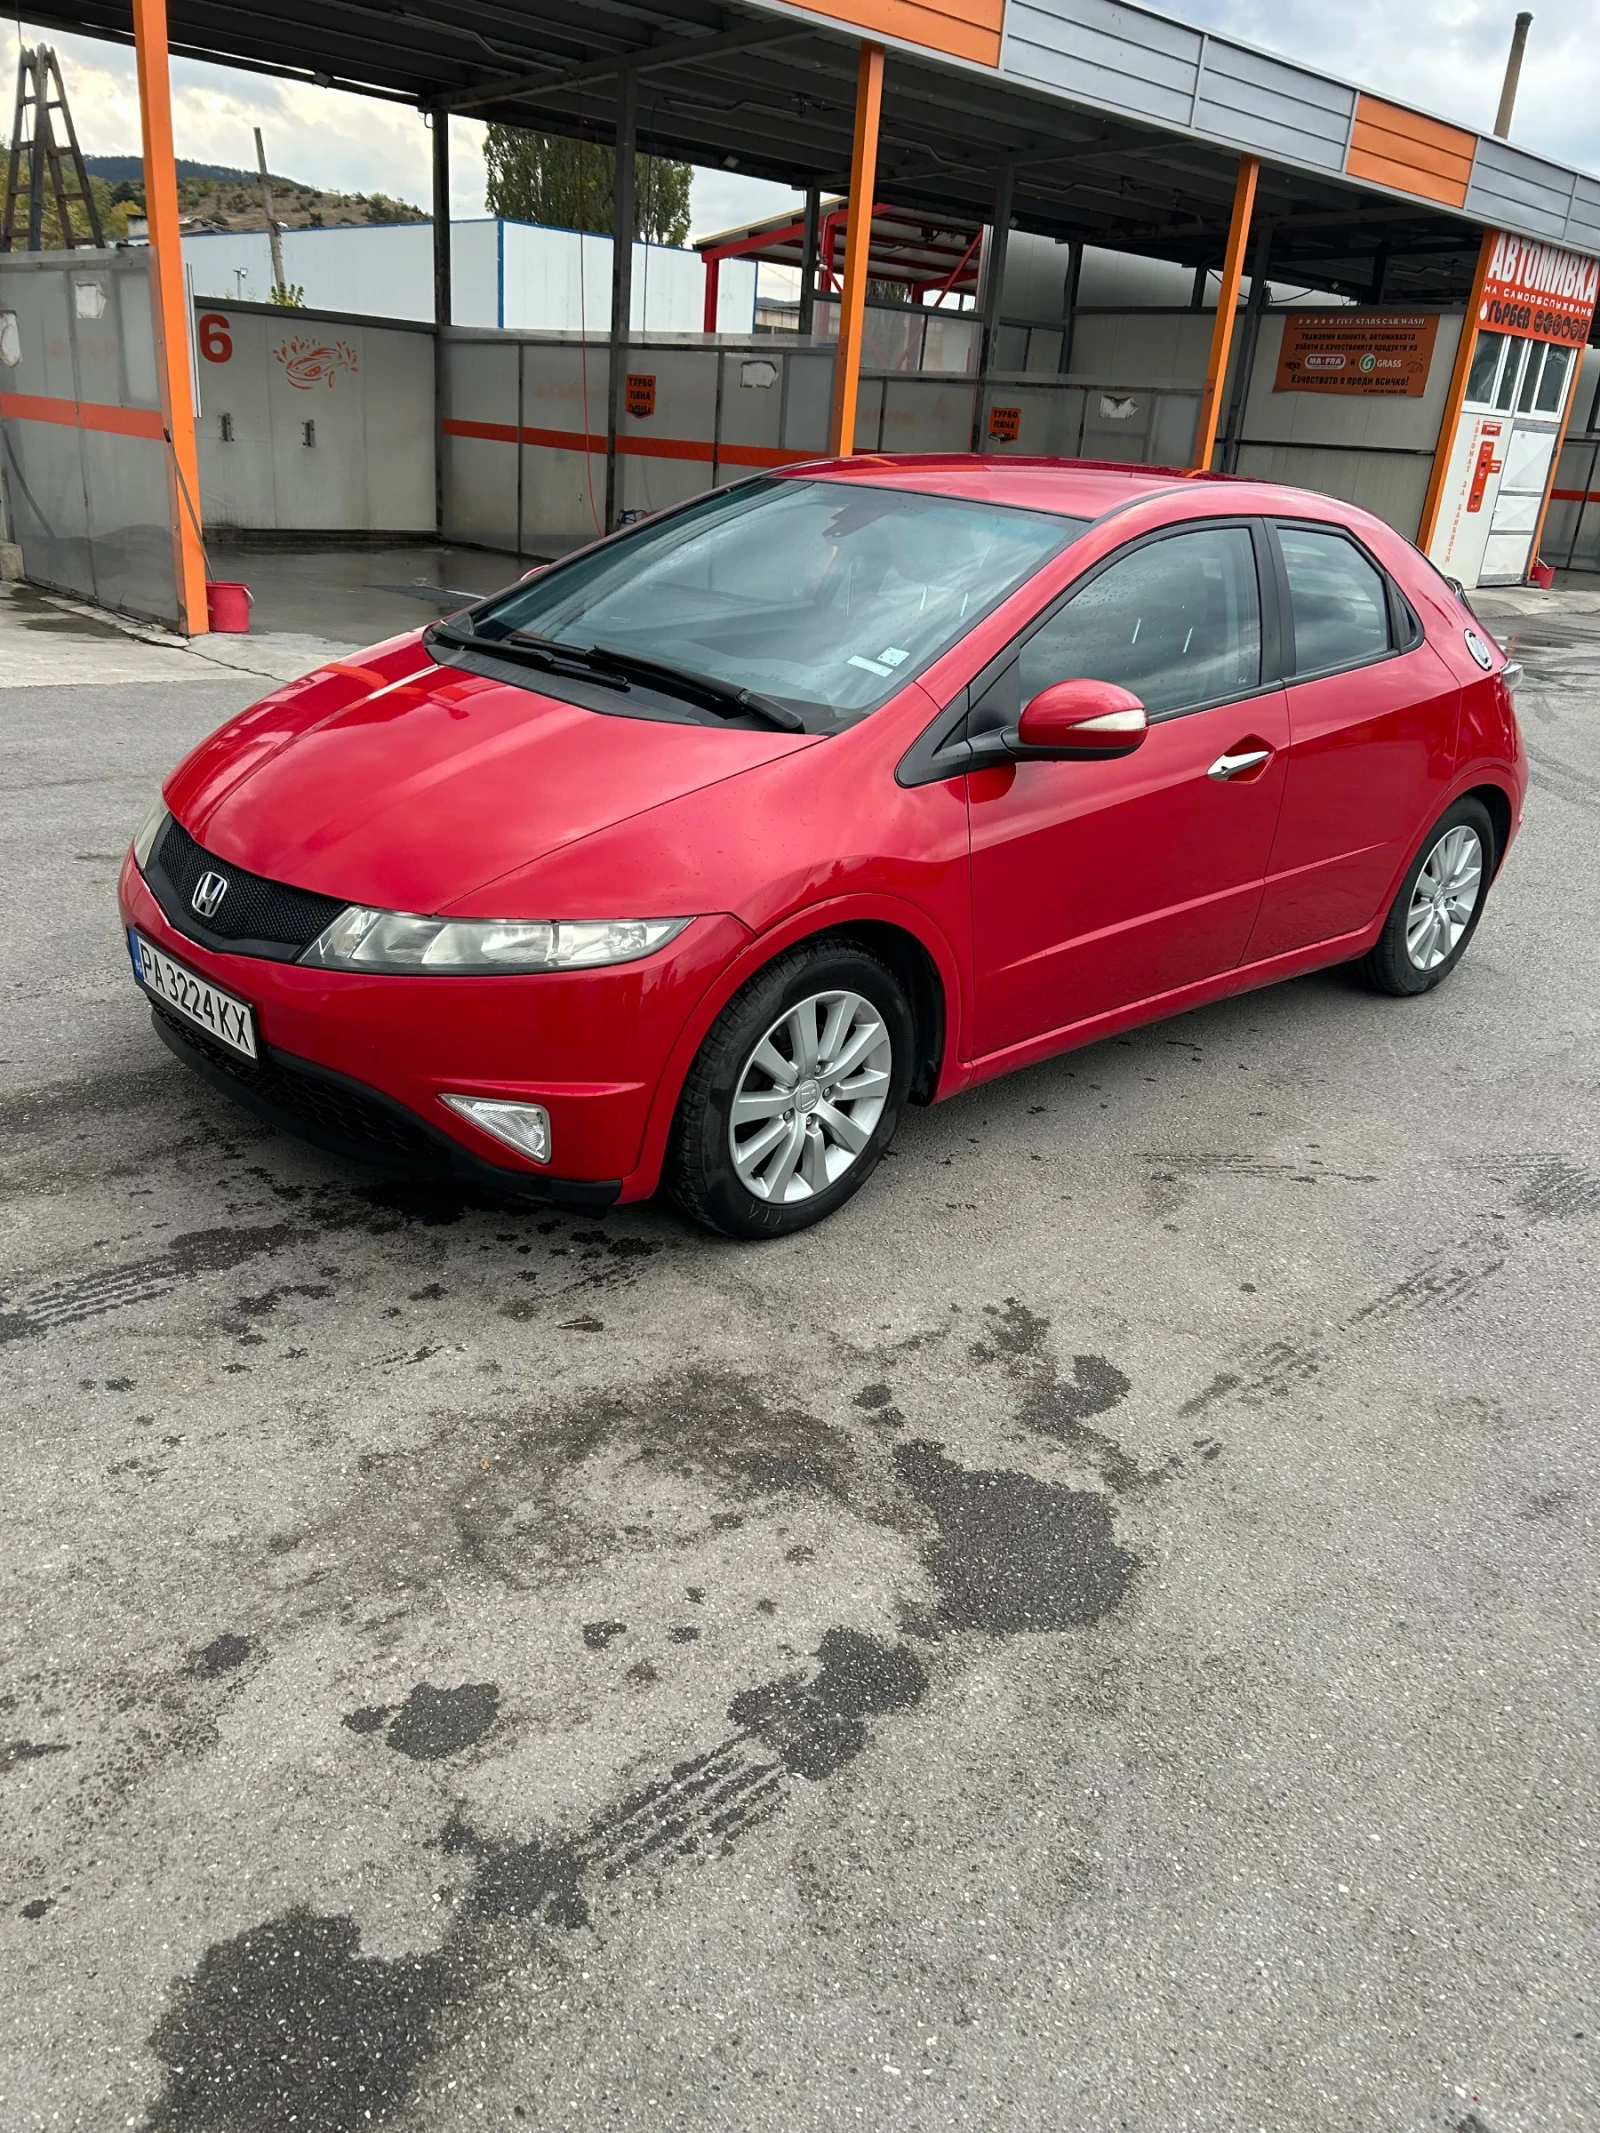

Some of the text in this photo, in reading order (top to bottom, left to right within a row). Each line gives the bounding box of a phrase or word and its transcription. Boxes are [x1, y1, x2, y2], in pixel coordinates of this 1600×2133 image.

[1488, 232, 1600, 304] АВТОМИВКА
[1484, 283, 1497, 295] НА
[199, 313, 233, 363] 6
[1377, 359, 1402, 368] GRASS
[629, 377, 653, 388] ТУРБО
[1291, 374, 1410, 386] Качеството е преди всичко!
[993, 410, 1019, 418] ТУРБО
[141, 943, 251, 1050] PA3224KX
